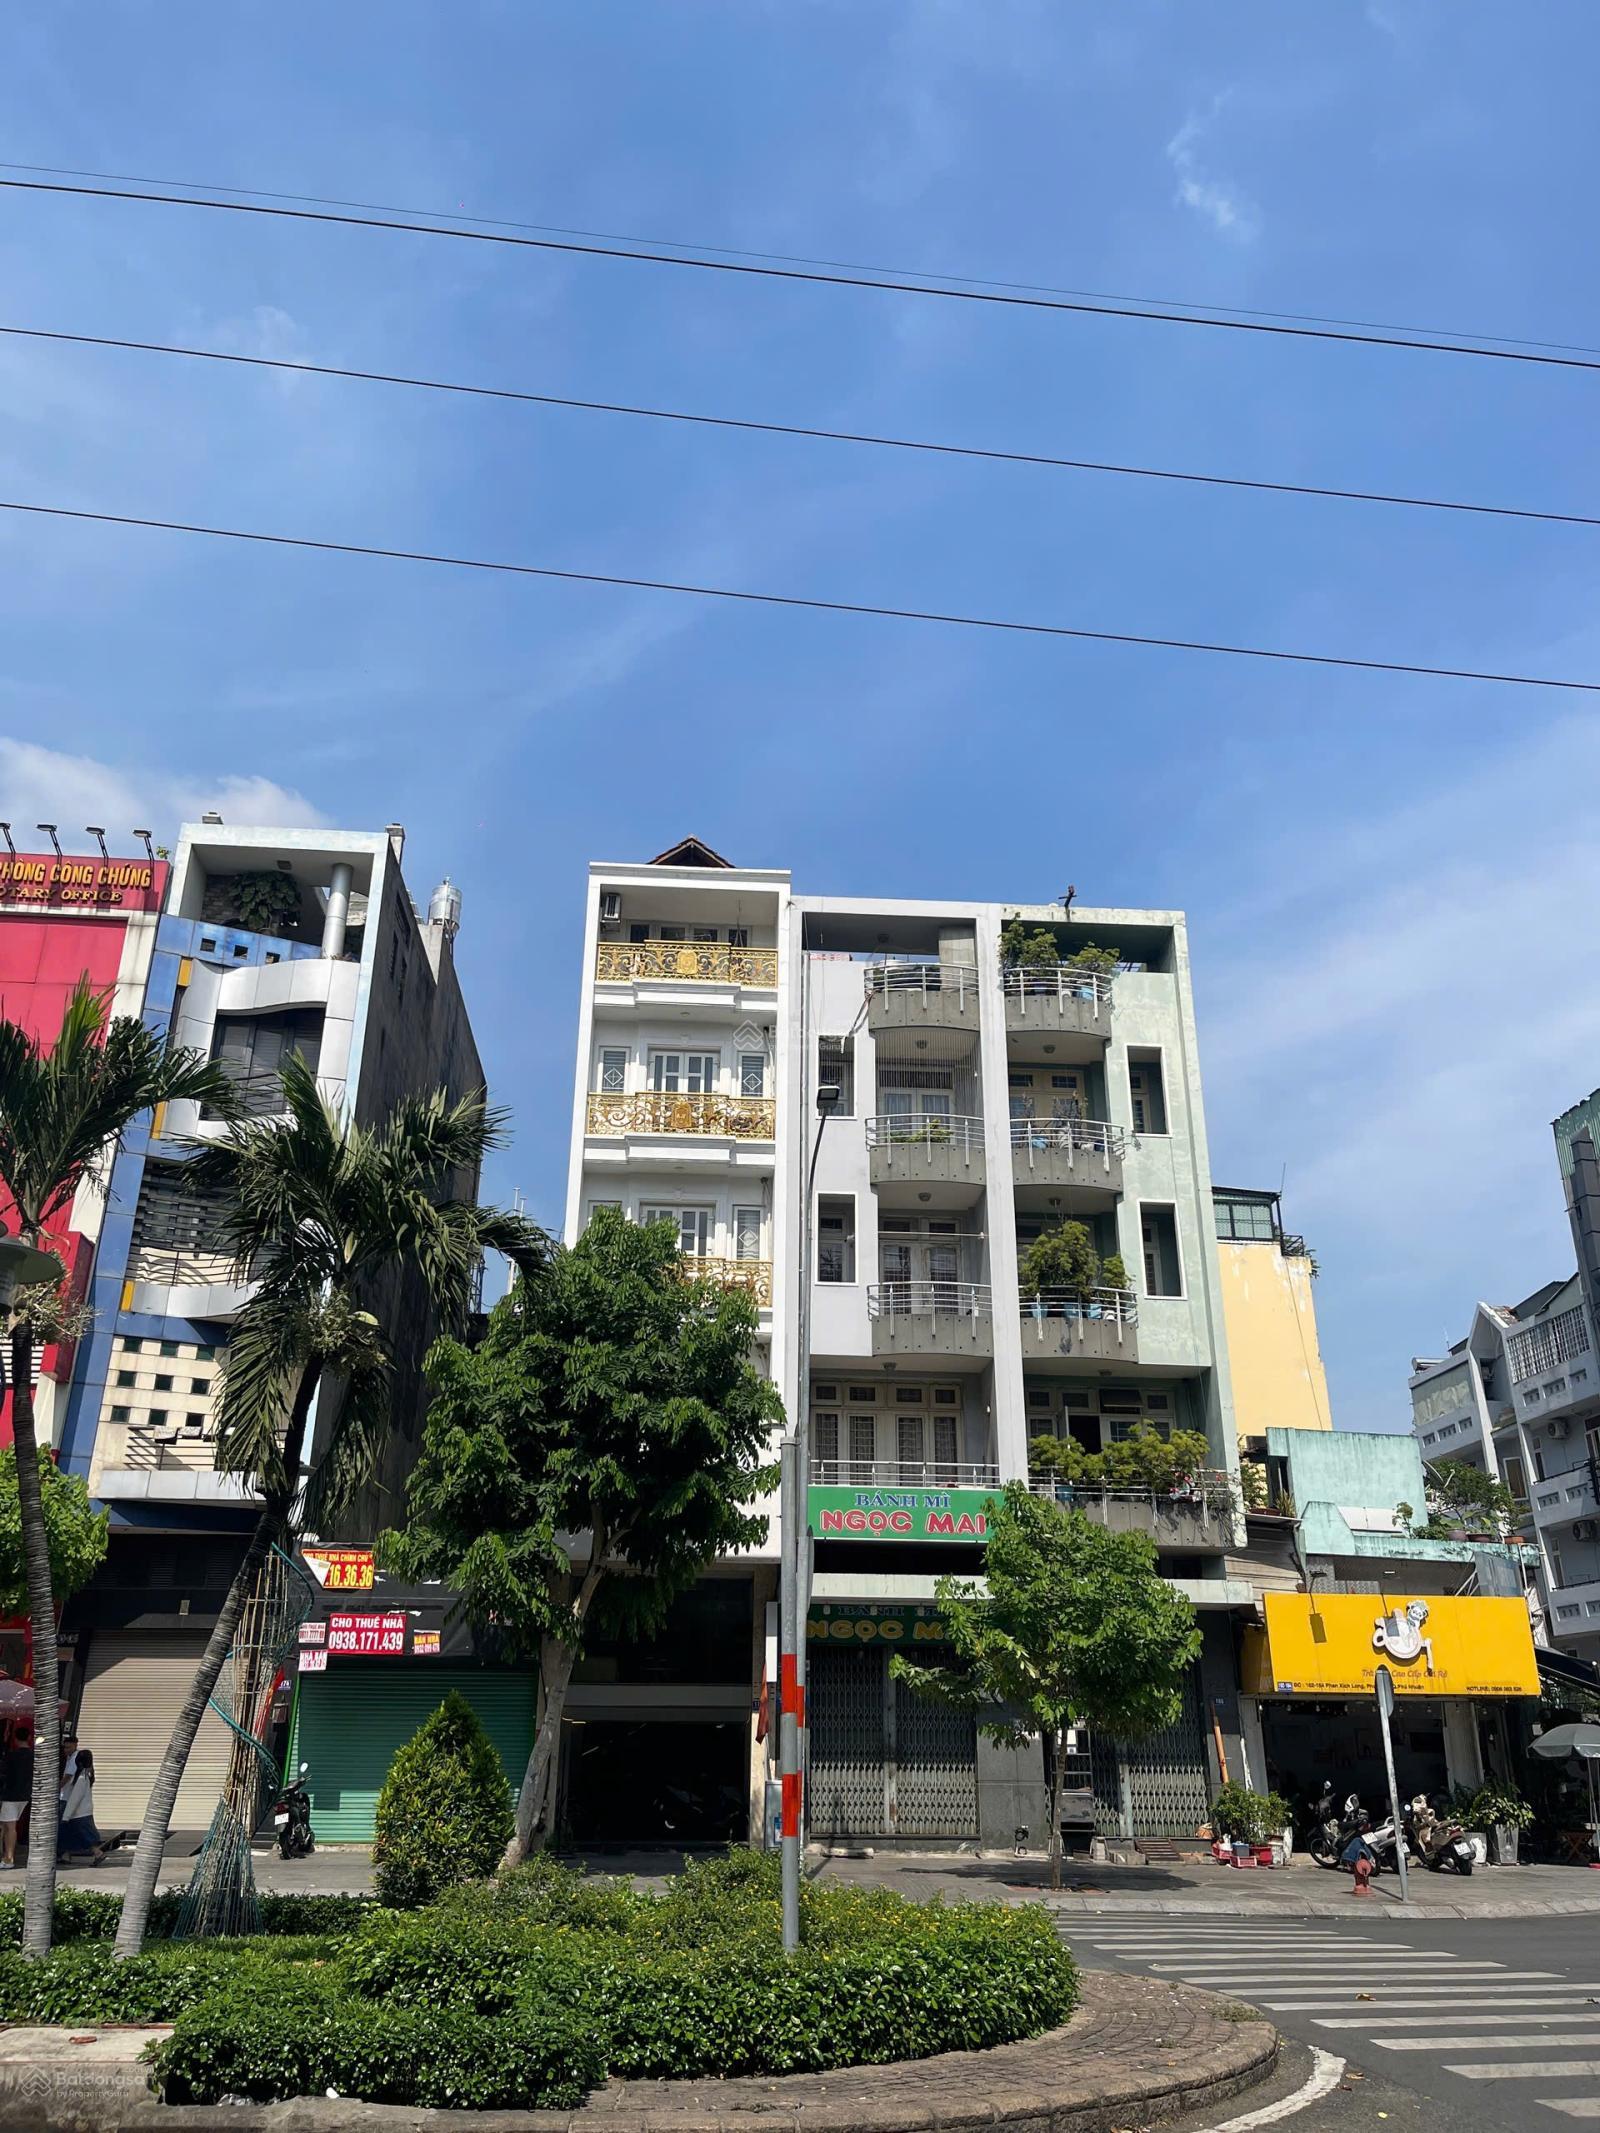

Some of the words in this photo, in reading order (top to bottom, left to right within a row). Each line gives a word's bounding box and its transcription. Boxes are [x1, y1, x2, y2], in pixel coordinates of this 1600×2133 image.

[0, 858, 45, 882] HÒNG
[50, 861, 93, 884] CÔNG
[97, 863, 151, 887] CHỨNG
[0, 886, 57, 899] OTARY
[61, 890, 122, 902] OFFICE
[855, 1490, 918, 1507] BÁNH
[923, 1492, 951, 1508] MÌ
[820, 1509, 913, 1537] NGỌC
[925, 1512, 987, 1535] MAI
[331, 1617, 353, 1628] CHO
[356, 1615, 380, 1628] THUÊ
[382, 1616, 404, 1629] NHÀ
[328, 1631, 403, 1650] 0938.171.439
